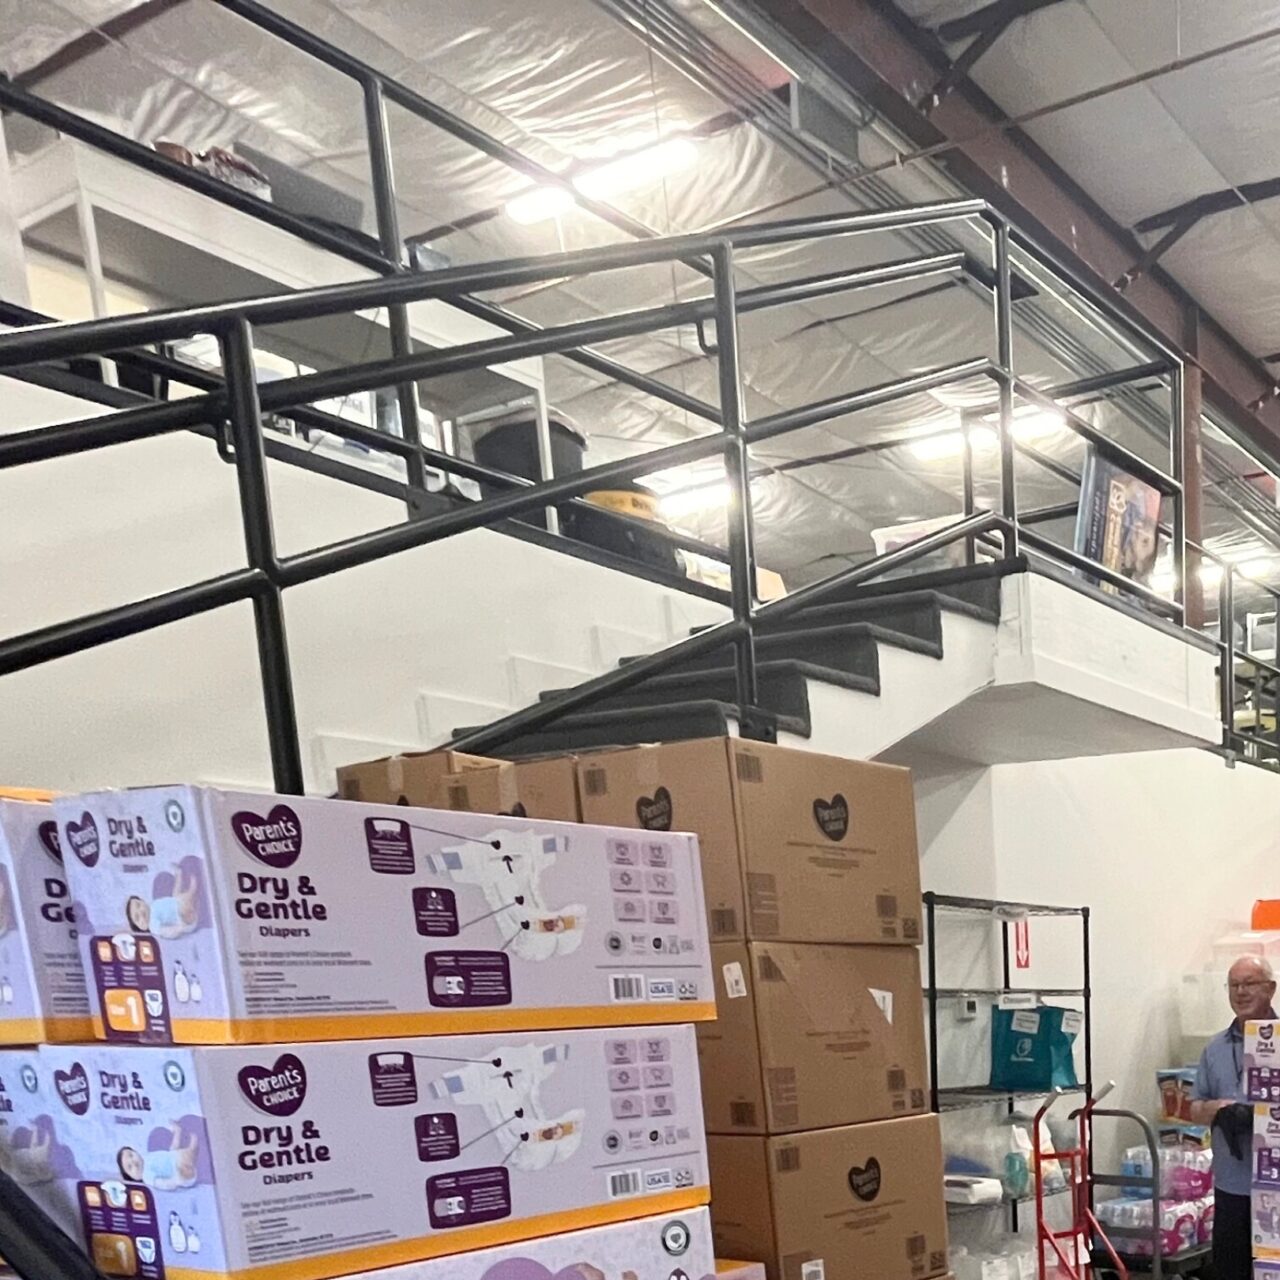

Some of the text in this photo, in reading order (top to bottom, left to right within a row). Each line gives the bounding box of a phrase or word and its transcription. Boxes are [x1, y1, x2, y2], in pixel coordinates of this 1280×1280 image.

[108, 815, 148, 839] Dry &
[242, 814, 298, 842] Parent's
[108, 837, 156, 859] Gentle
[258, 838, 296, 857] CHOICE
[237, 872, 317, 900] Dry &
[234, 899, 327, 921] Gentle
[259, 926, 310, 940] Diapers
[126, 996, 139, 1026] 1
[100, 1070, 143, 1093] Dry &
[247, 1066, 302, 1095] Parent's
[101, 1090, 151, 1111] Gentle
[262, 1087, 300, 1107] CHOICE
[1260, 1087, 1268, 1099] 3
[242, 1120, 321, 1149] Dry &
[238, 1142, 331, 1172] Gentle
[263, 1169, 313, 1186] Diapers
[1270, 1168, 1278, 1179] 3
